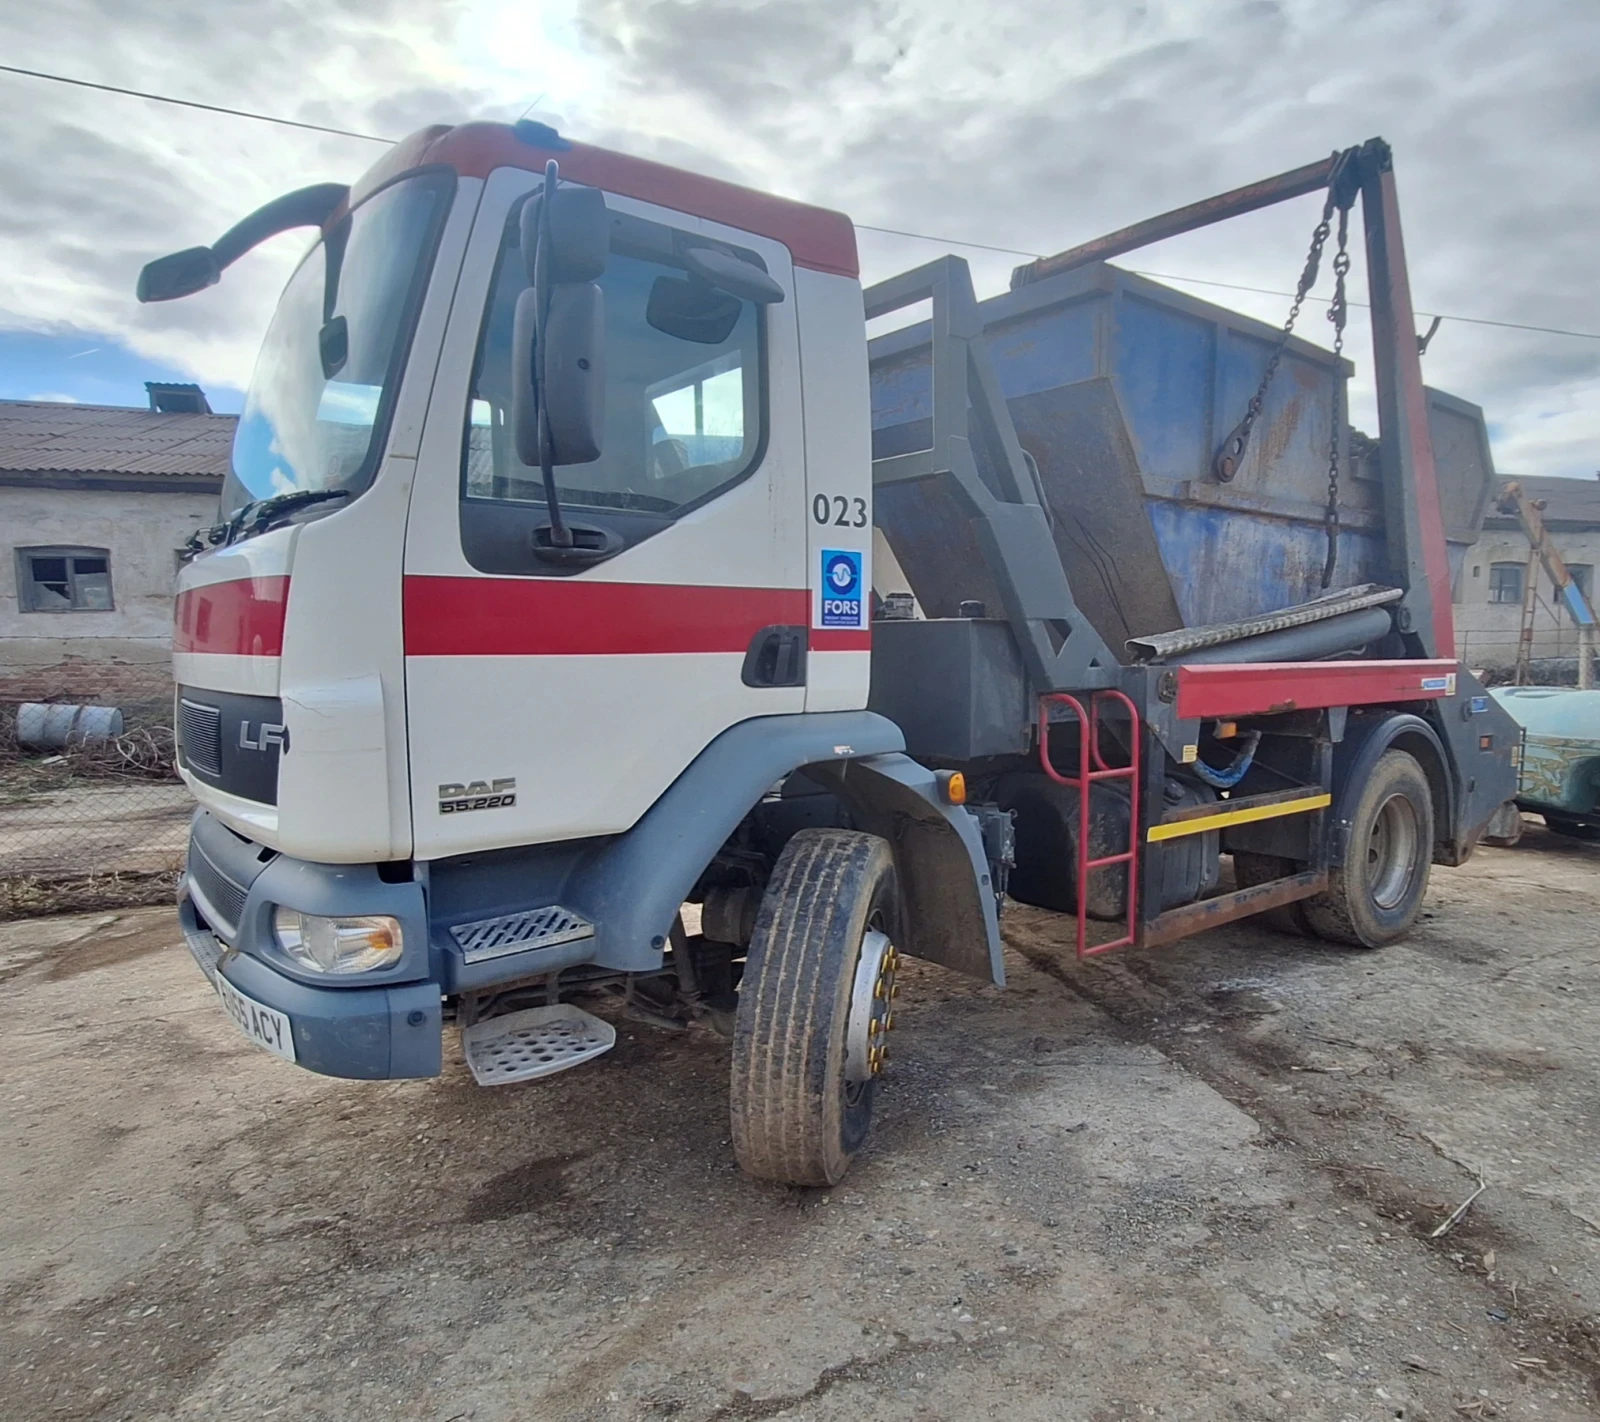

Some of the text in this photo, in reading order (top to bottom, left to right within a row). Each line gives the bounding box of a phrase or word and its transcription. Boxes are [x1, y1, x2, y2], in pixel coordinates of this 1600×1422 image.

[813, 493, 867, 528] 023
[824, 600, 859, 615] FORS
[240, 720, 284, 751] LF
[439, 777, 516, 798] DAF
[440, 795, 515, 813] 55.220
[251, 1005, 282, 1050] ACY
